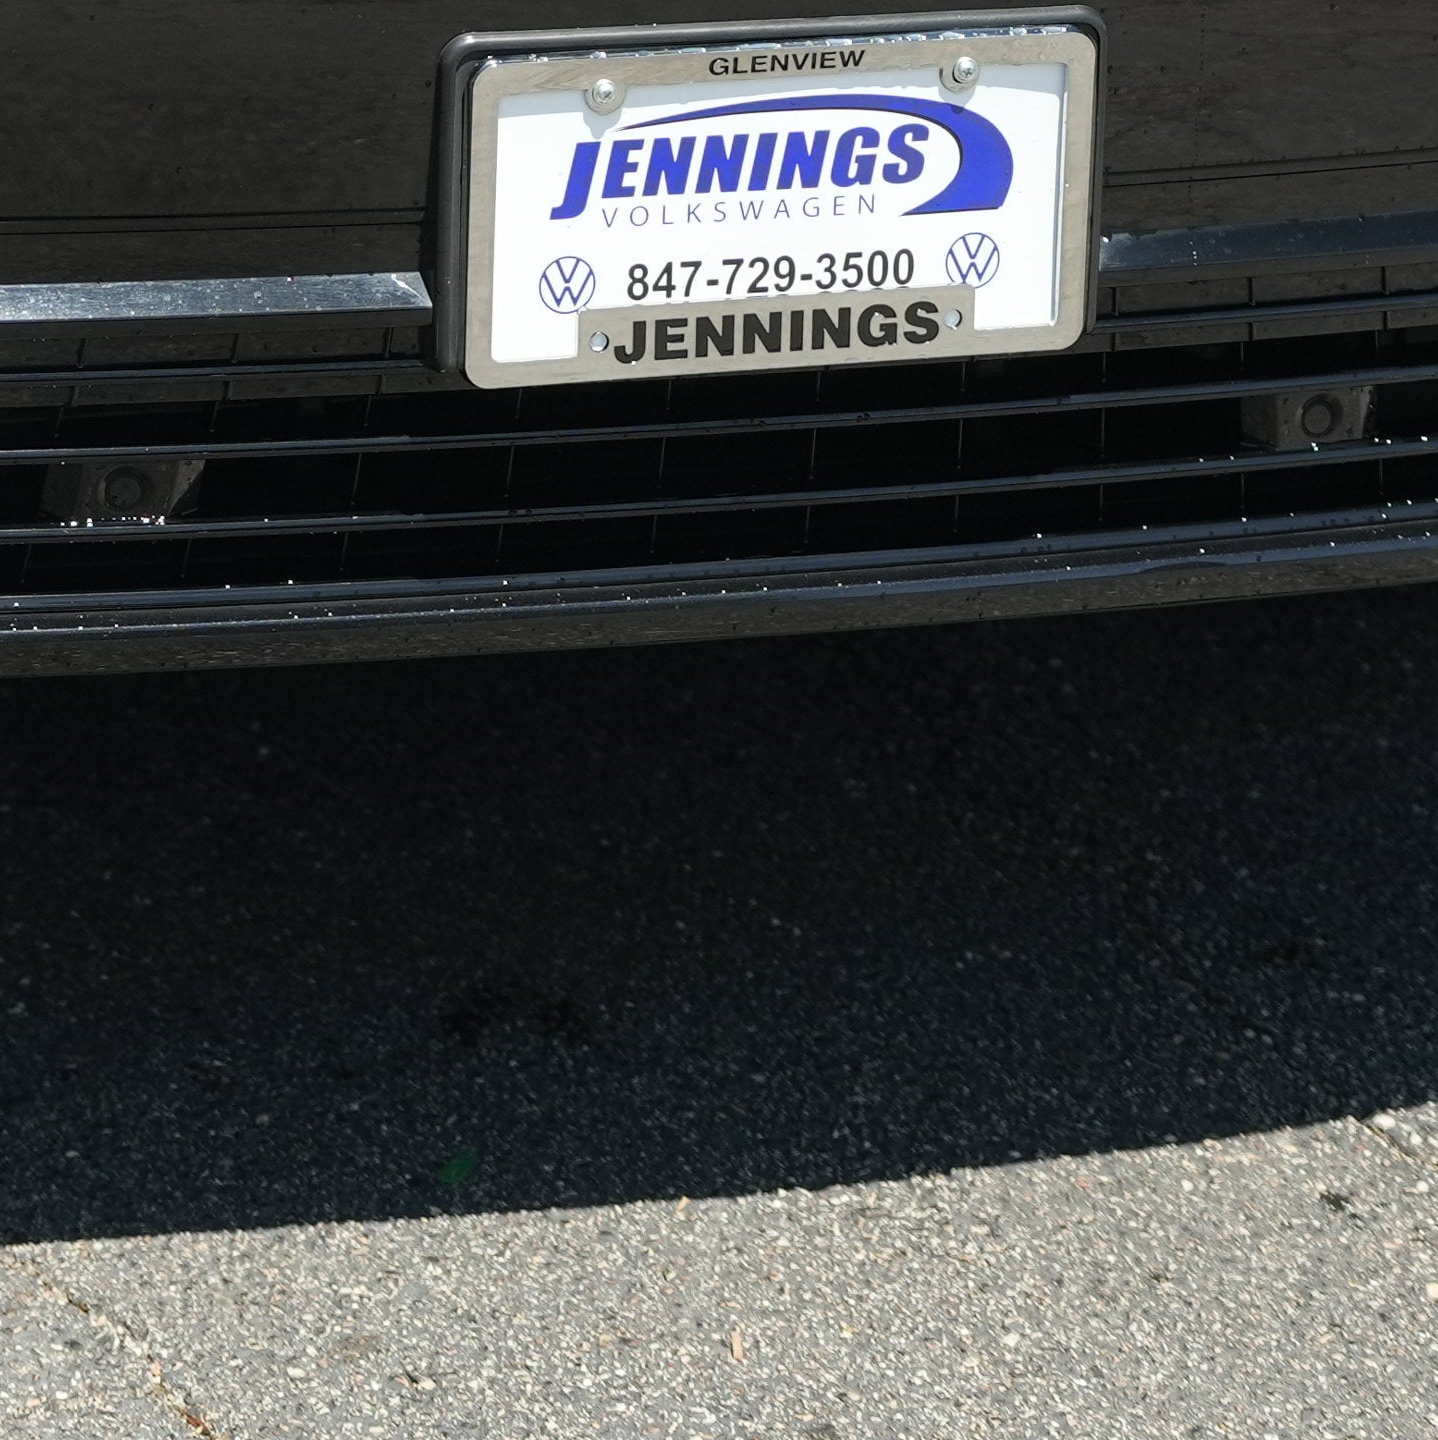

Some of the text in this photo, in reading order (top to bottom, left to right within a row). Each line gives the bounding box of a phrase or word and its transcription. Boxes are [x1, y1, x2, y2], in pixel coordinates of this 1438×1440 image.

[707, 48, 867, 77] GLENVIEW
[550, 122, 930, 221] JENNINGS
[602, 193, 877, 229] VOLKSWAGEN
[626, 248, 916, 302] 847-729-3500
[613, 301, 940, 365] JENNINGS
